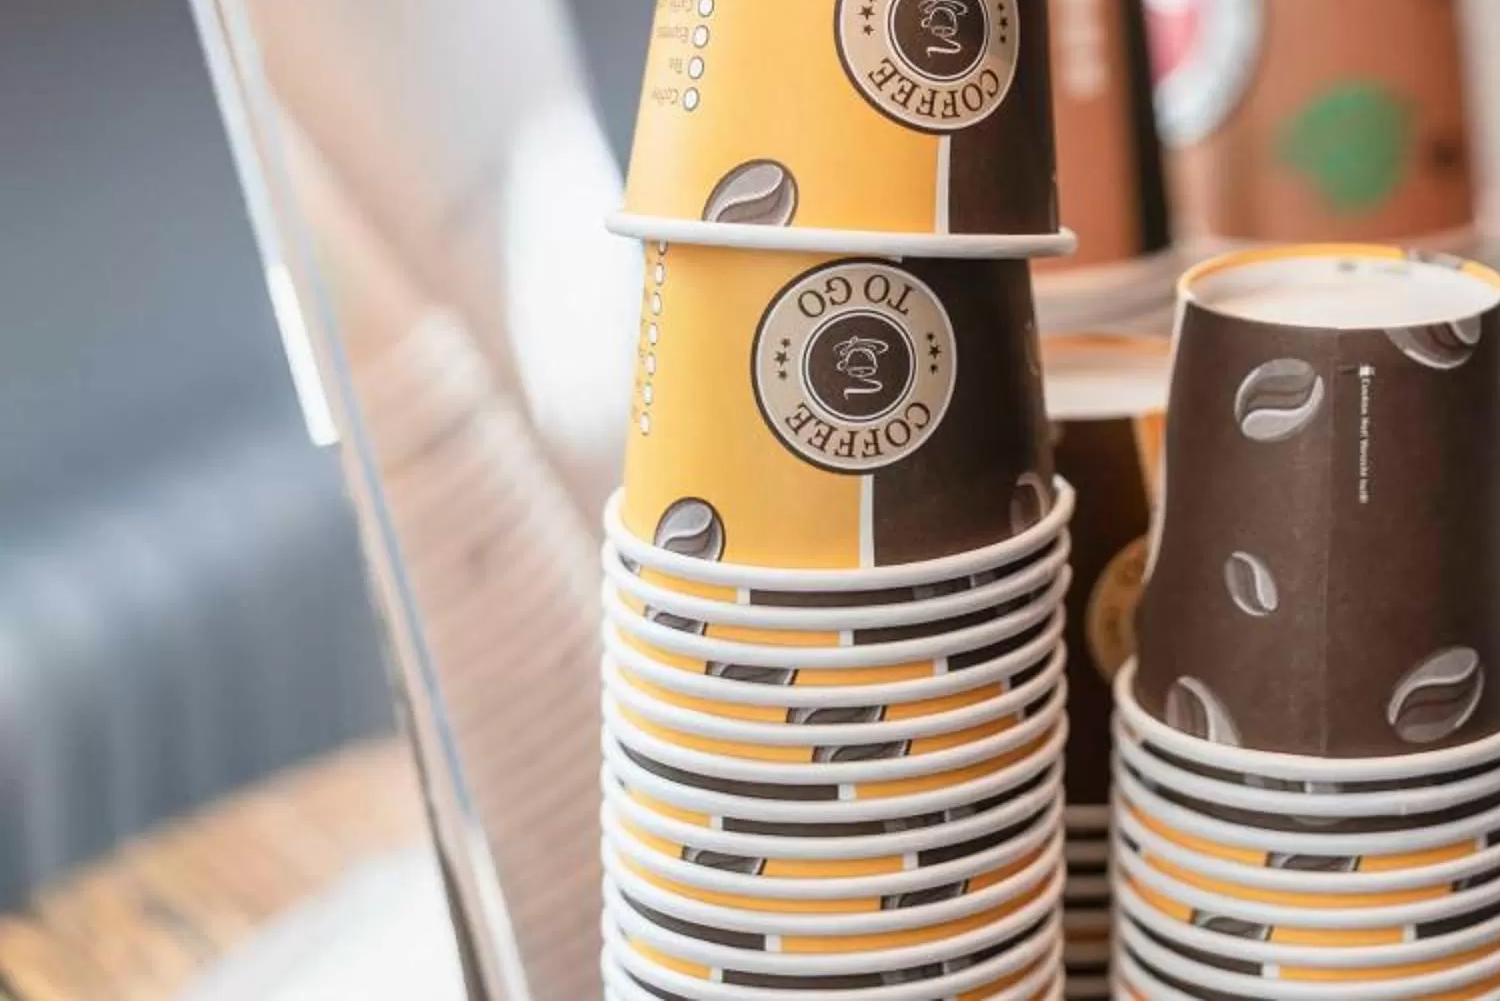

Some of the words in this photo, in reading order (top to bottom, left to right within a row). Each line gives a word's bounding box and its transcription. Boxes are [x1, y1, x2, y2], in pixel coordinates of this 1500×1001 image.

[867, 57, 1000, 120] COFFEE
[797, 275, 852, 319] GO
[863, 274, 915, 315] TO
[784, 401, 931, 458] COFFEE
